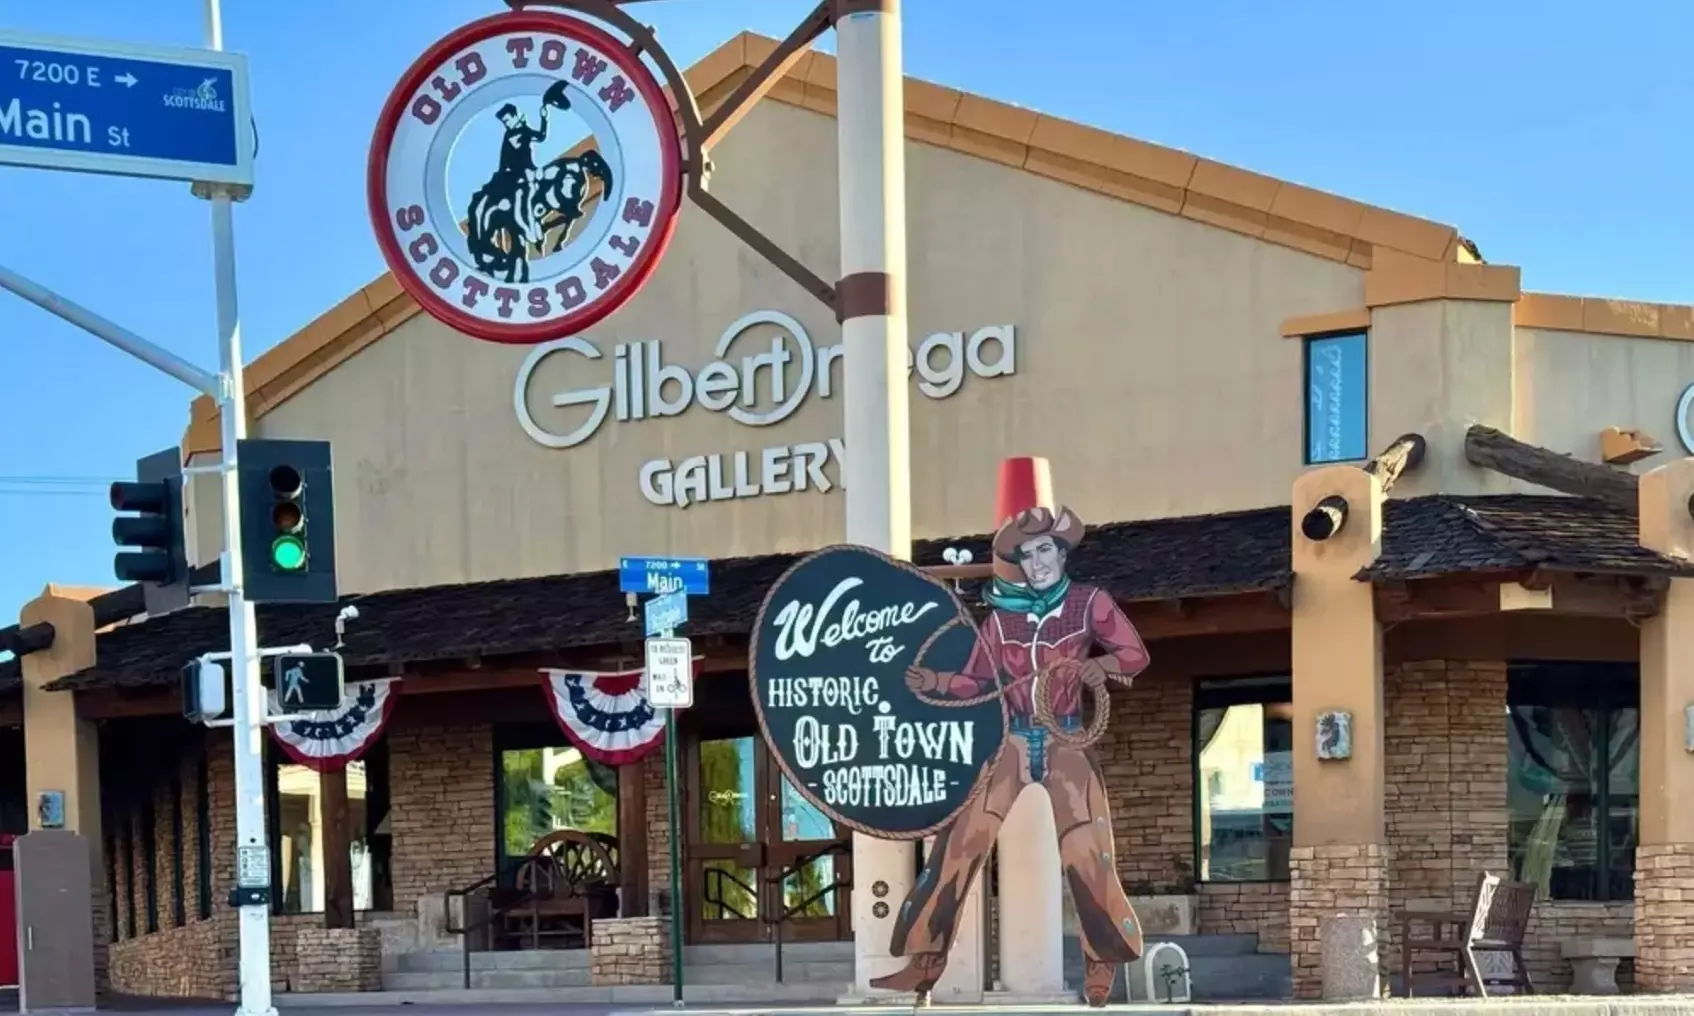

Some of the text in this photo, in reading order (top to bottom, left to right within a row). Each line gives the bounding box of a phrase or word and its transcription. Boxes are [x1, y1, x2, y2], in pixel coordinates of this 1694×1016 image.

[14, 59, 102, 88] 7200 E
[411, 36, 635, 126] OLD TOWN
[0, 97, 131, 148] Main St
[162, 93, 226, 113] SCOTTSDALE
[395, 196, 654, 319] SCOTTSDALE
[513, 308, 1017, 449] Gilbert Orga
[646, 571, 684, 591] Main
[773, 576, 940, 661] Welcome
[865, 635, 906, 664] to
[768, 676, 880, 716] HISTORIC
[792, 711, 975, 770] OLD TOWN
[822, 764, 947, 808] SCOTTSDALE
